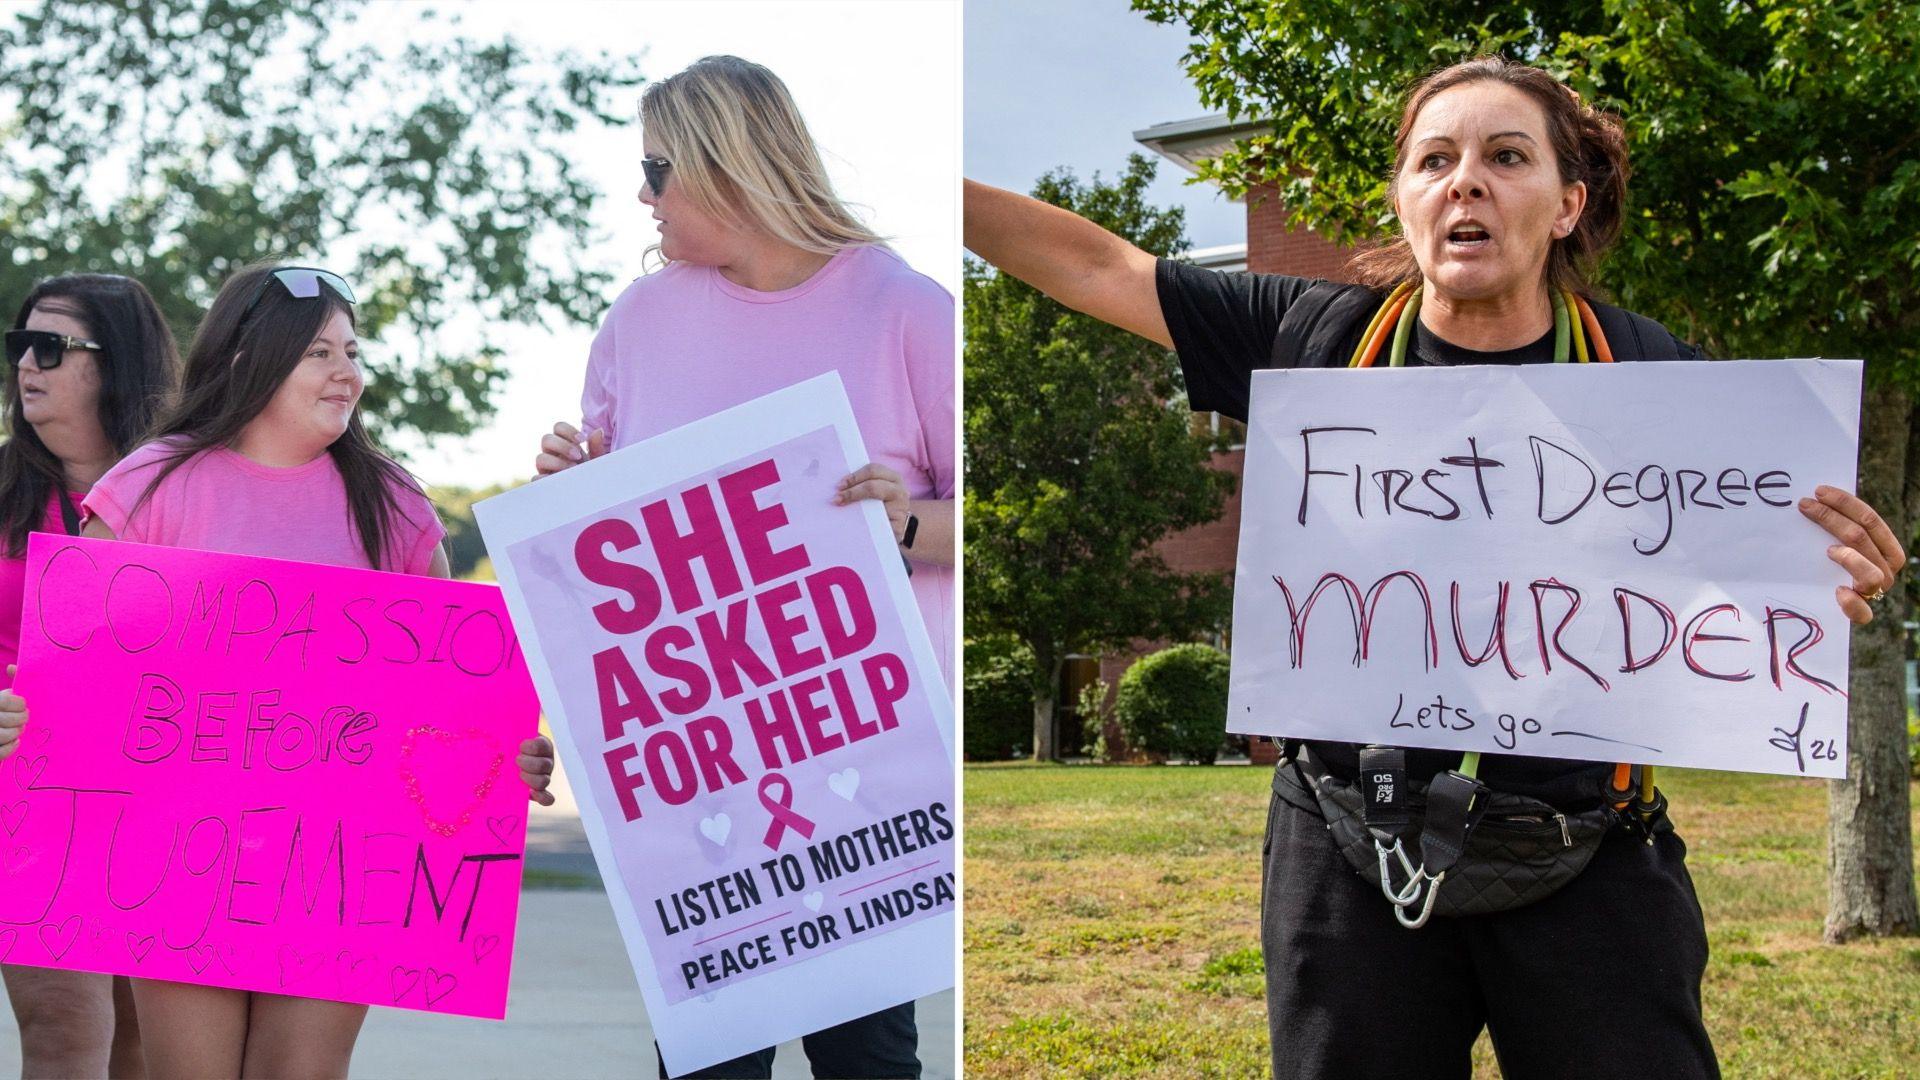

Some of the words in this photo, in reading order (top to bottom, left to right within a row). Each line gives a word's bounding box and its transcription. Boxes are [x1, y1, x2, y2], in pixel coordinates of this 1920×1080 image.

[574, 459, 811, 635] SHE
[592, 565, 878, 742] ASKED
[603, 714, 748, 823] FOR
[746, 651, 911, 769] HELP
[1391, 694, 1475, 730] Lets
[1494, 713, 1542, 750] go
[1810, 739, 1838, 761] 26
[1373, 774, 1393, 783] 50
[655, 868, 761, 936] LISTEN
[761, 854, 805, 897] TO
[807, 802, 954, 883] MOTHERS
[681, 935, 776, 990] PEACE
[780, 915, 841, 956] FOR
